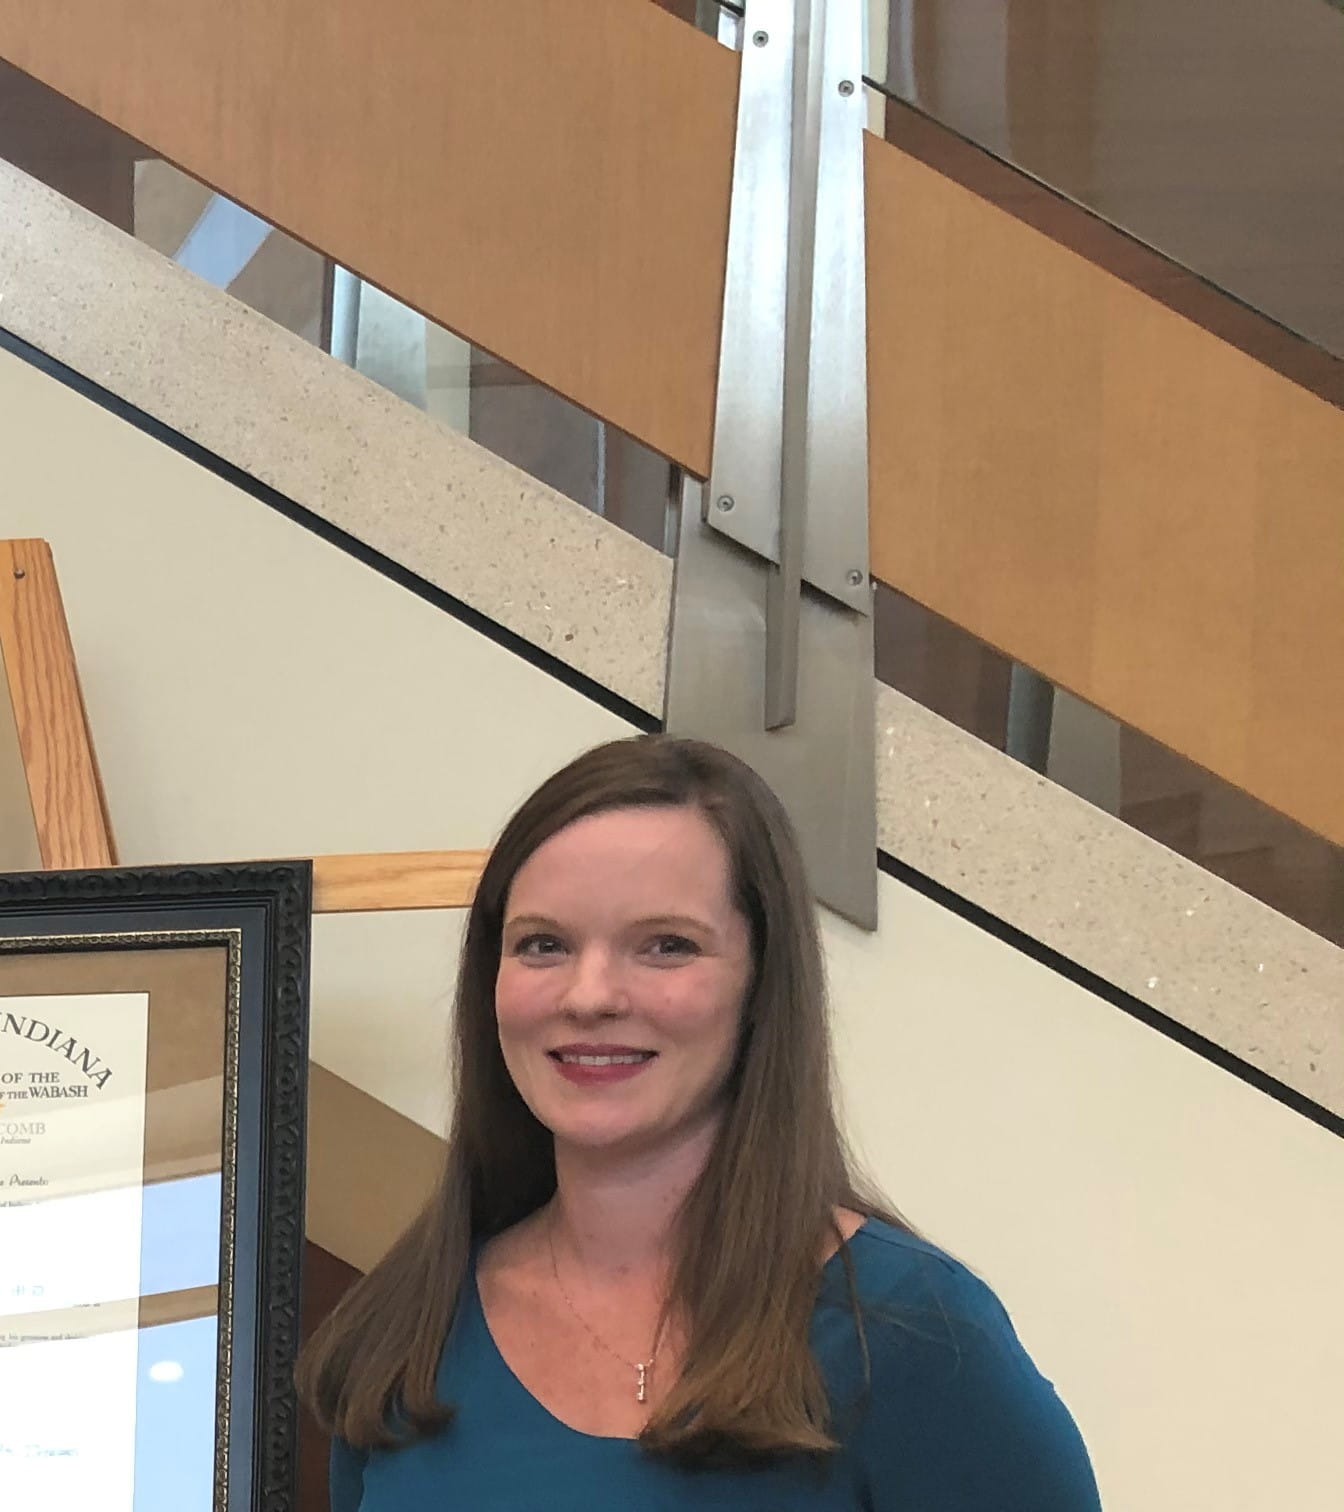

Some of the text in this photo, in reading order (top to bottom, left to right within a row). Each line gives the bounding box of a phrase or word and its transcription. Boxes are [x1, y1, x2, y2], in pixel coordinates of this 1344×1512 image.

[1, 1072, 24, 1084] OF
[28, 1072, 61, 1083] THE
[7, 1090, 28, 1099] THE
[29, 1085, 89, 1099] WABASH
